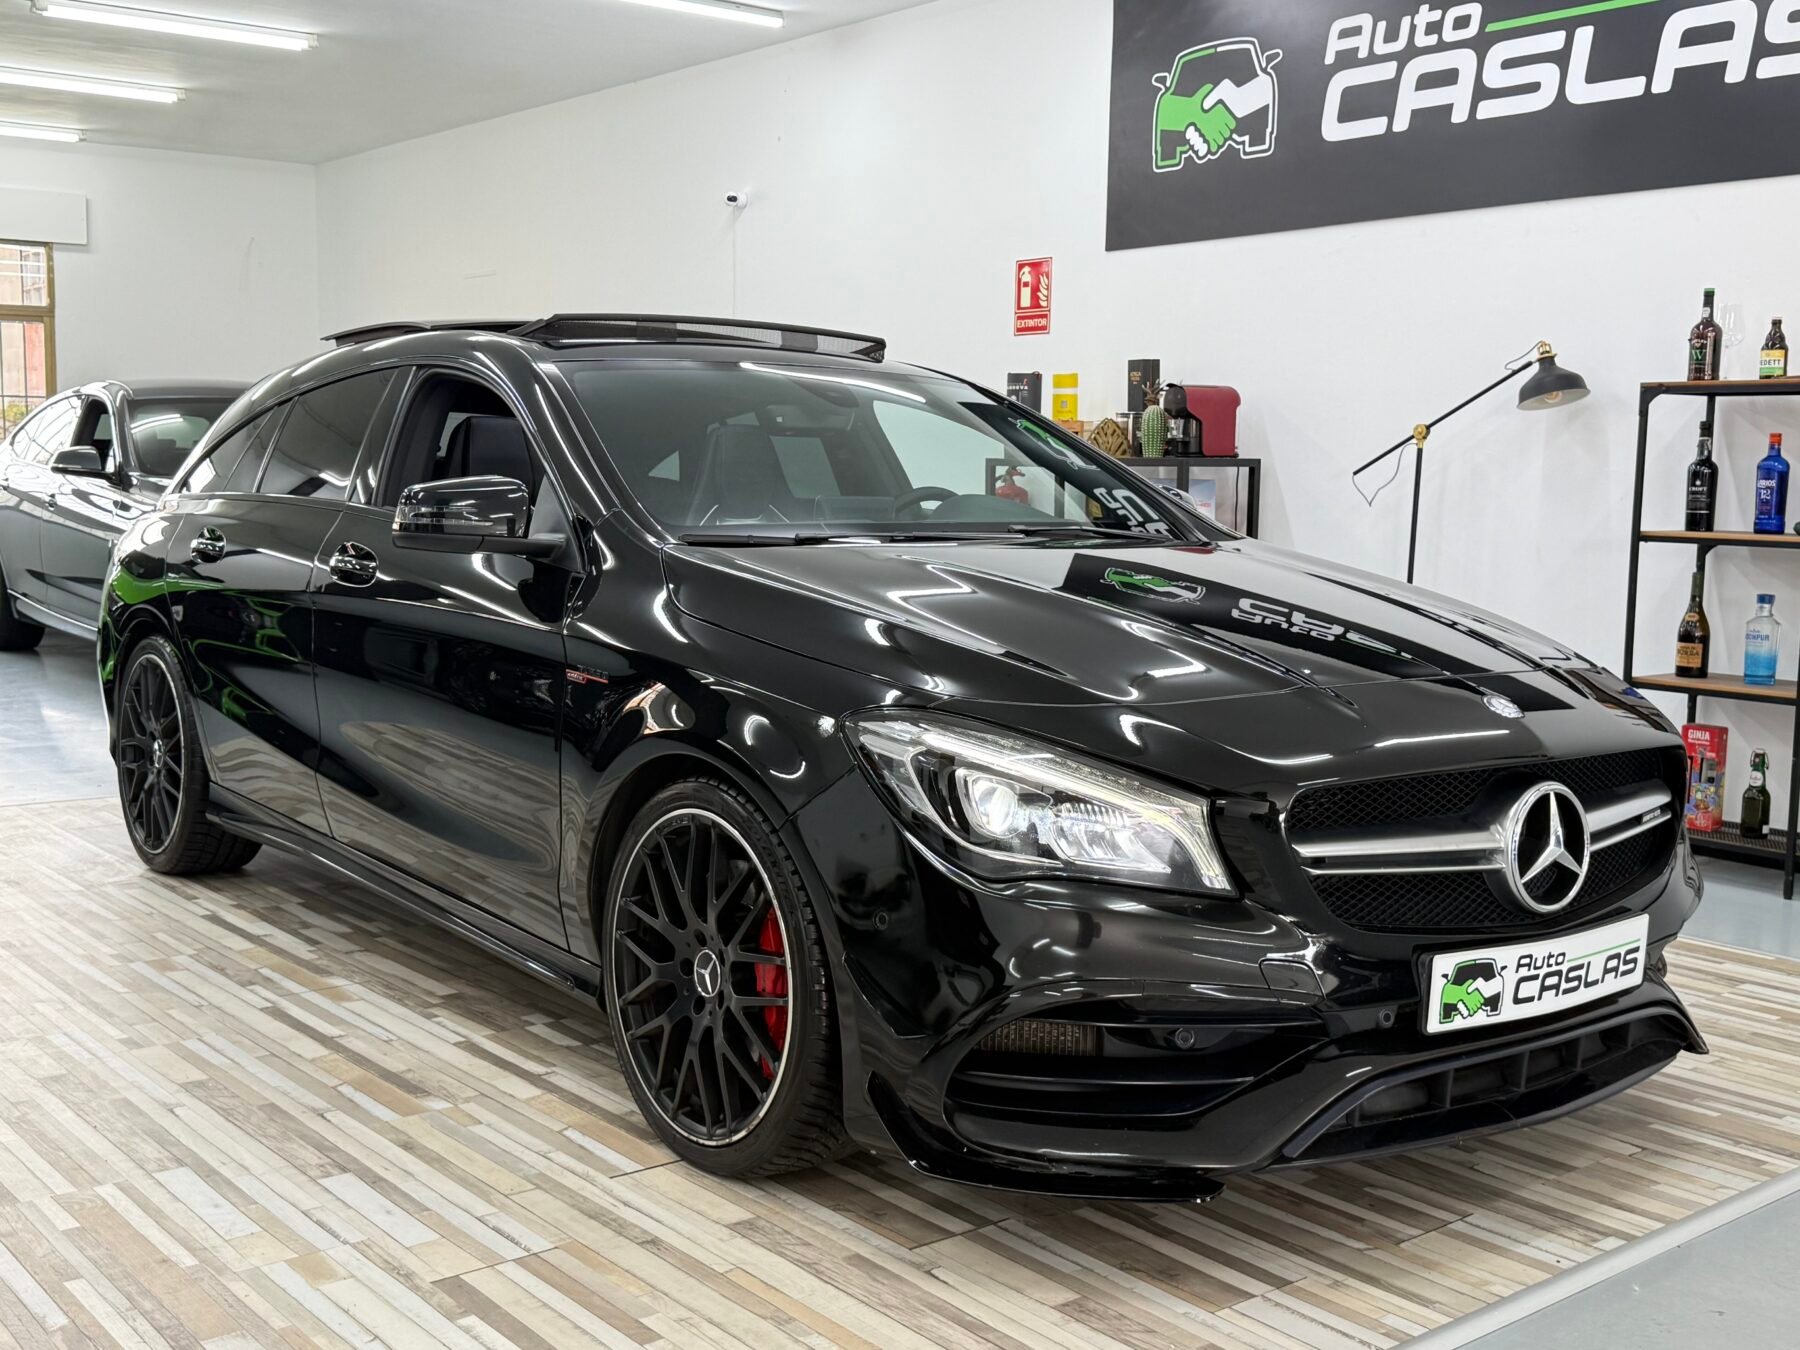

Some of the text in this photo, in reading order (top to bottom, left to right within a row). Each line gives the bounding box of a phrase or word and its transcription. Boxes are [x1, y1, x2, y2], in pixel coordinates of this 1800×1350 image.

[1325, 2, 1483, 65] Auto
[1017, 318, 1047, 328] EXTINTOR
[1759, 488, 1771, 500] 12
[1688, 729, 1710, 741] GINJA
[1516, 951, 1566, 974] Auto
[1513, 946, 1641, 1005] CASLAS
